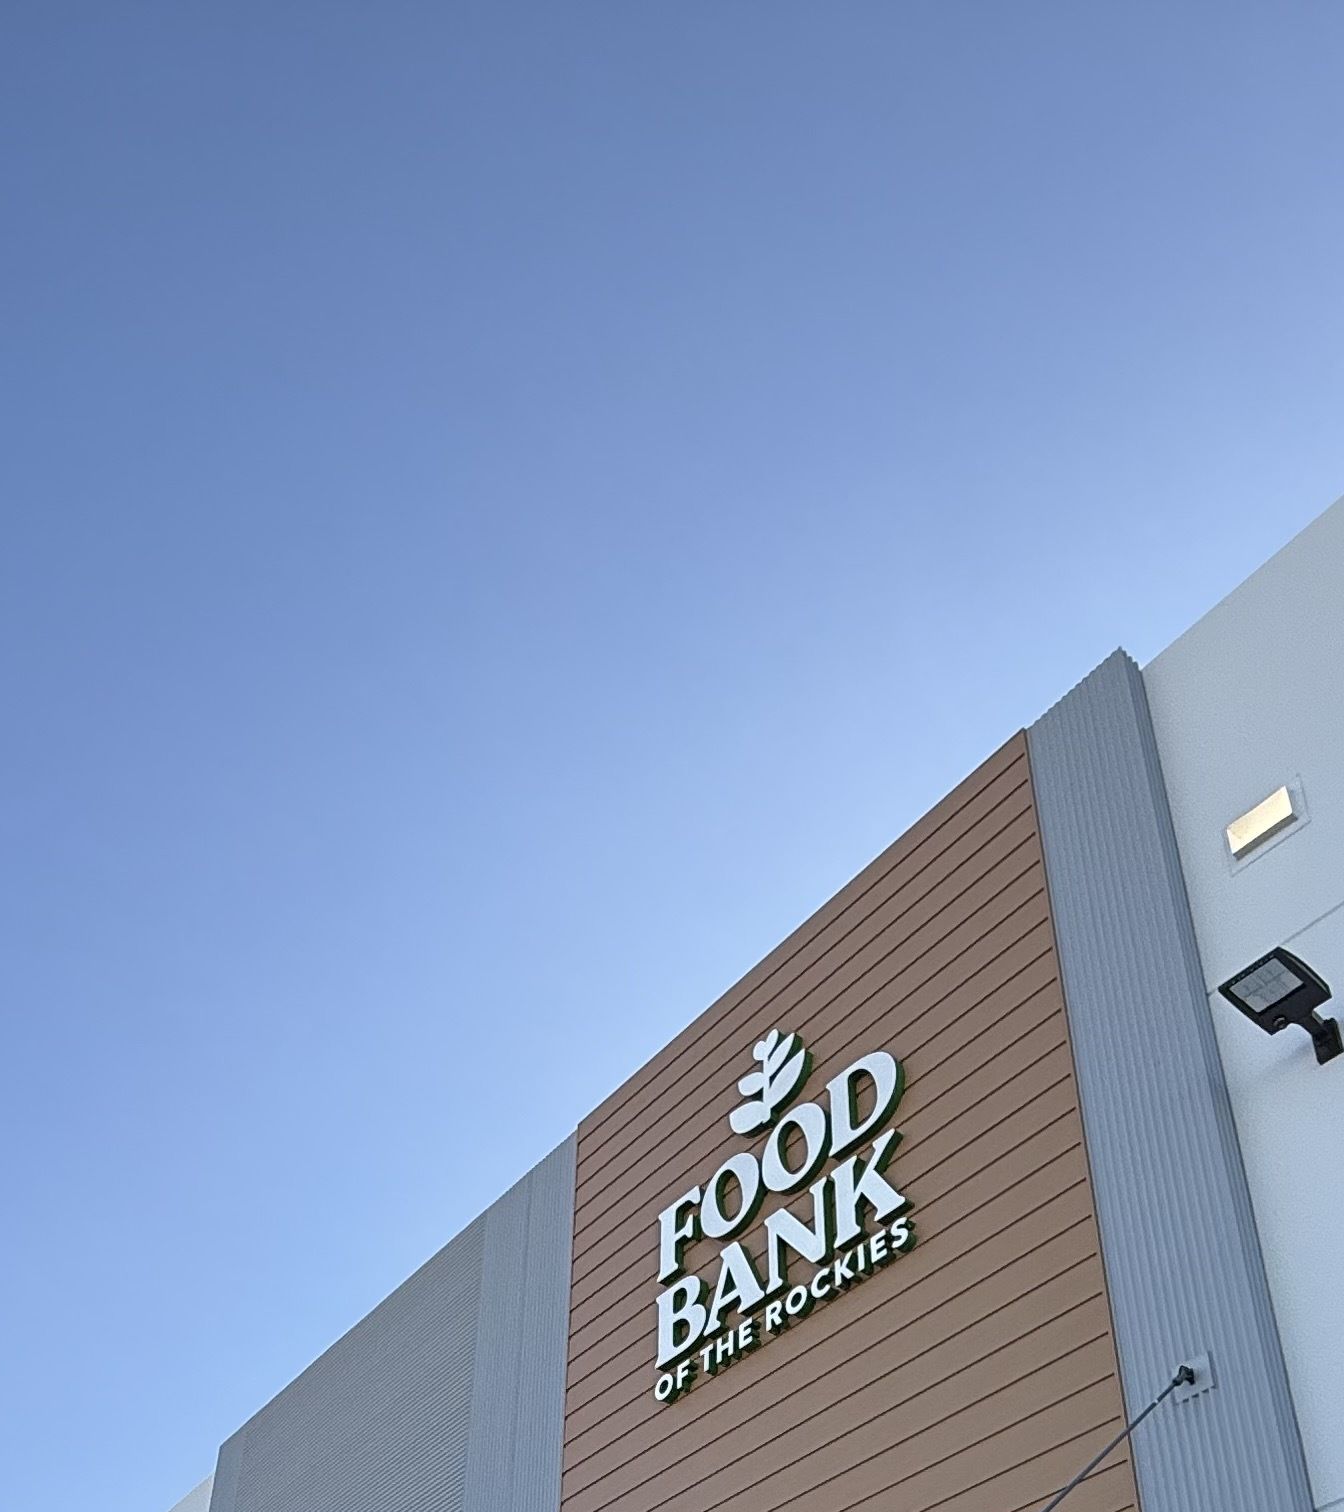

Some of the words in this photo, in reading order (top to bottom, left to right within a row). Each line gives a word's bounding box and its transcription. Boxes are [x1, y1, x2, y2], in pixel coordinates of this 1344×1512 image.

[655, 1128, 907, 1369] BANK
[657, 1051, 899, 1282] FOOD
[655, 1360, 690, 1401] OF
[699, 1317, 754, 1372] THE
[765, 1217, 911, 1333] ROCKIES
